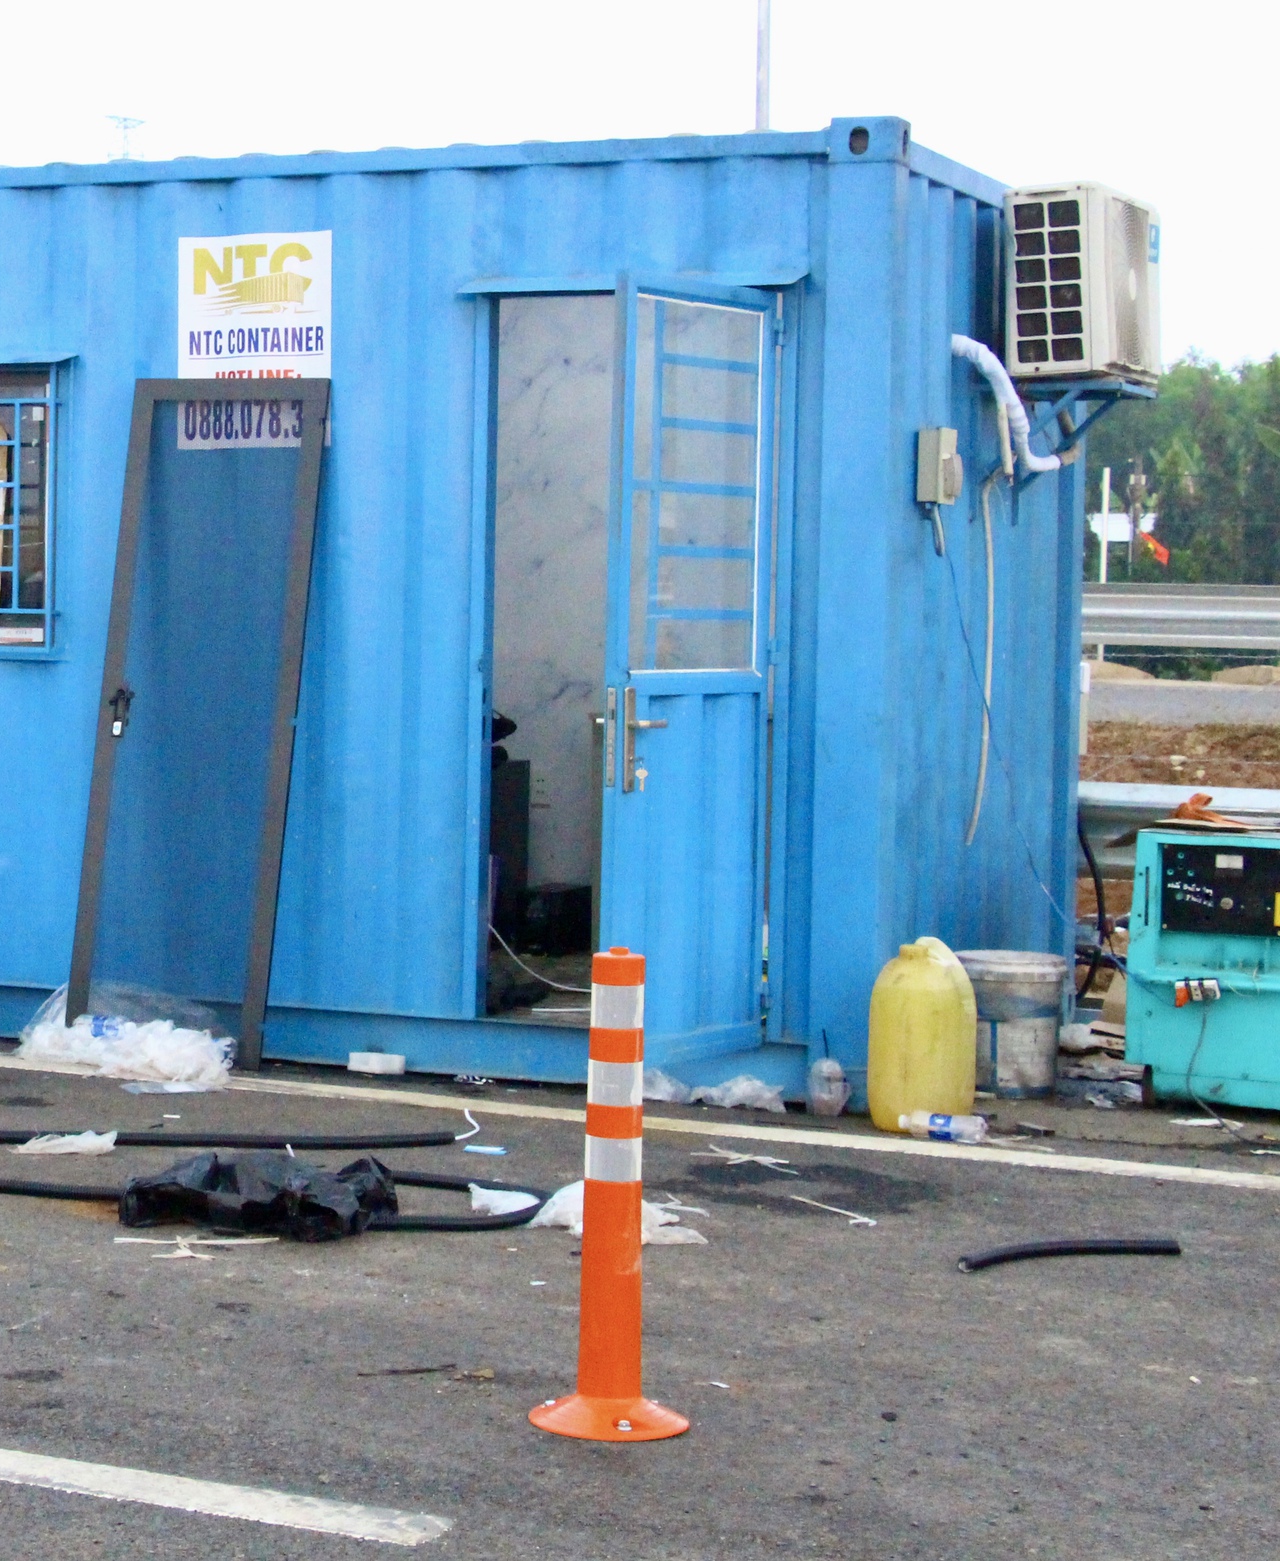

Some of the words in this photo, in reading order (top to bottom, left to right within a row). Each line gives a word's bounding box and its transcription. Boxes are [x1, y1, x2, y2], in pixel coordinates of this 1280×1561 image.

[193, 242, 313, 295] NTC
[189, 330, 223, 356] NTC
[227, 325, 324, 355] CONTAINER
